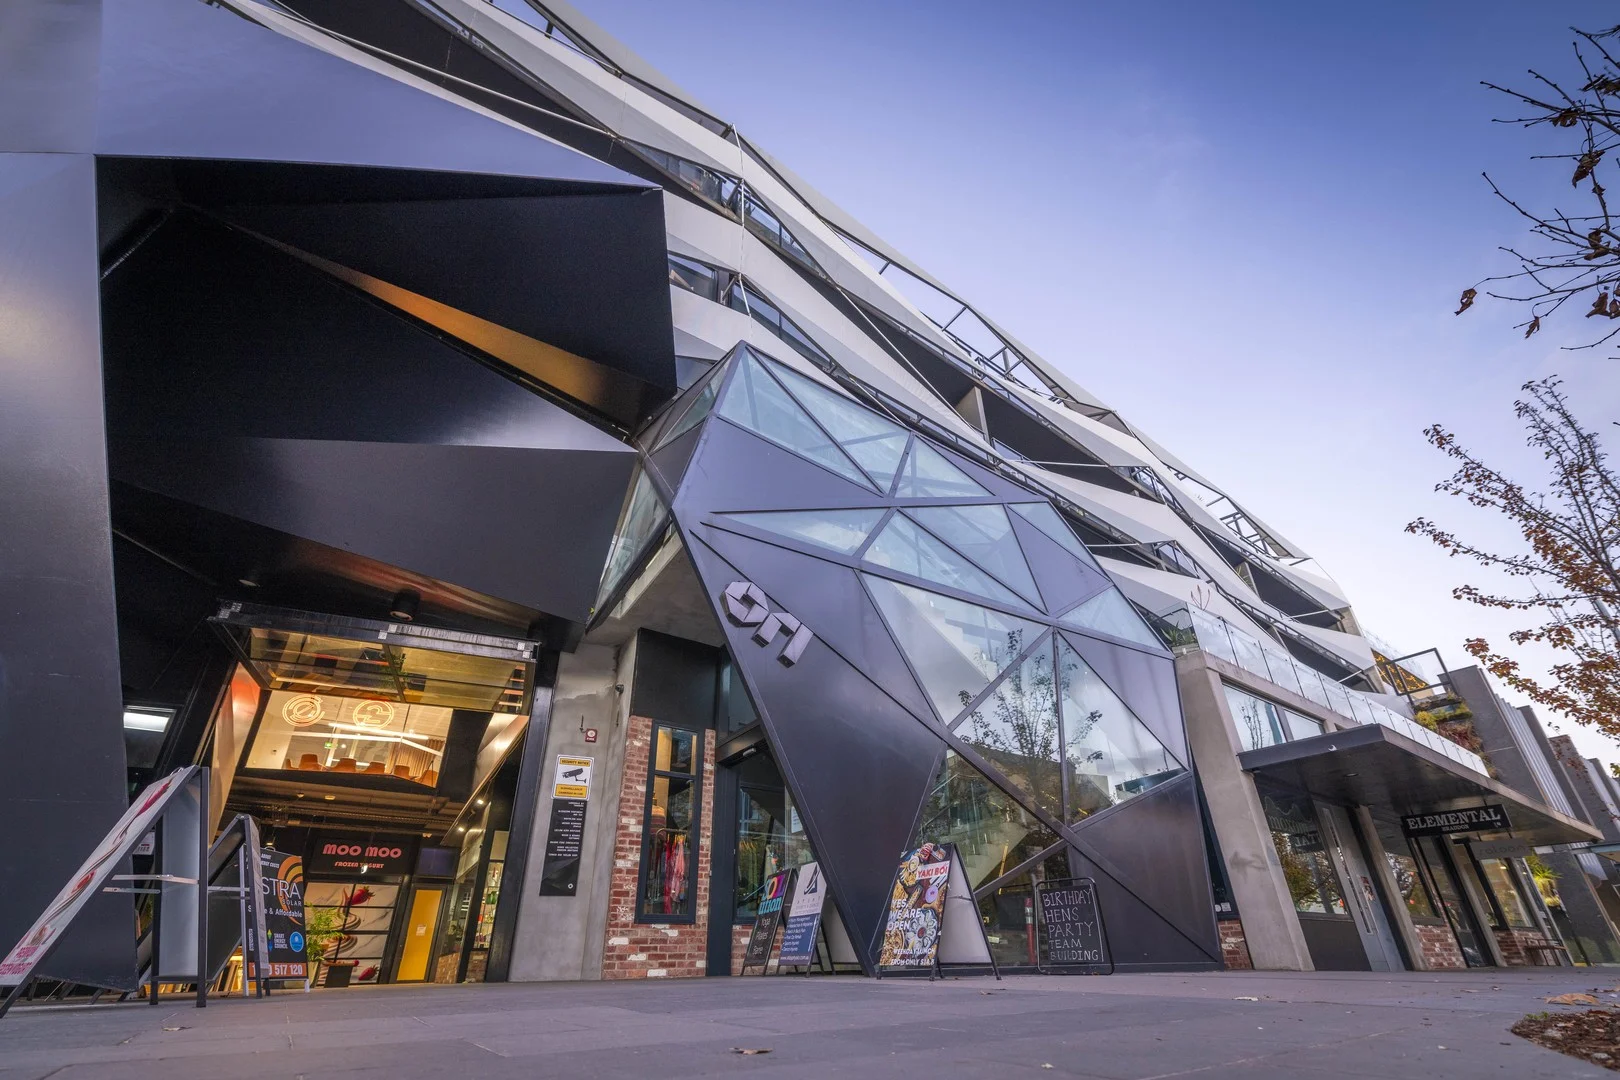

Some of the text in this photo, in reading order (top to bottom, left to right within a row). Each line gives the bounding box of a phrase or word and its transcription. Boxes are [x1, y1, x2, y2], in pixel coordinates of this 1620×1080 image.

[1406, 808, 1501, 829] ELEMENTAL
[1441, 824, 1470, 832] BRADDON
[322, 843, 402, 859] MOO MOO
[917, 868, 934, 878] YAKI
[261, 876, 301, 900] STRA
[1042, 887, 1093, 907] BIRTHDAY
[282, 899, 302, 907] SOLAR
[275, 908, 303, 917] Affordable
[888, 908, 922, 920] WE ARE
[1045, 907, 1079, 923] HENS
[761, 918, 771, 928] Yoga
[887, 920, 911, 931] OPEN
[1048, 921, 1093, 938] PARTY
[1049, 938, 1082, 949] TEAM
[1050, 949, 1099, 961] BUILDING
[905, 958, 920, 966] ONLY
[274, 964, 288, 975] 517
[289, 964, 303, 975] 120
